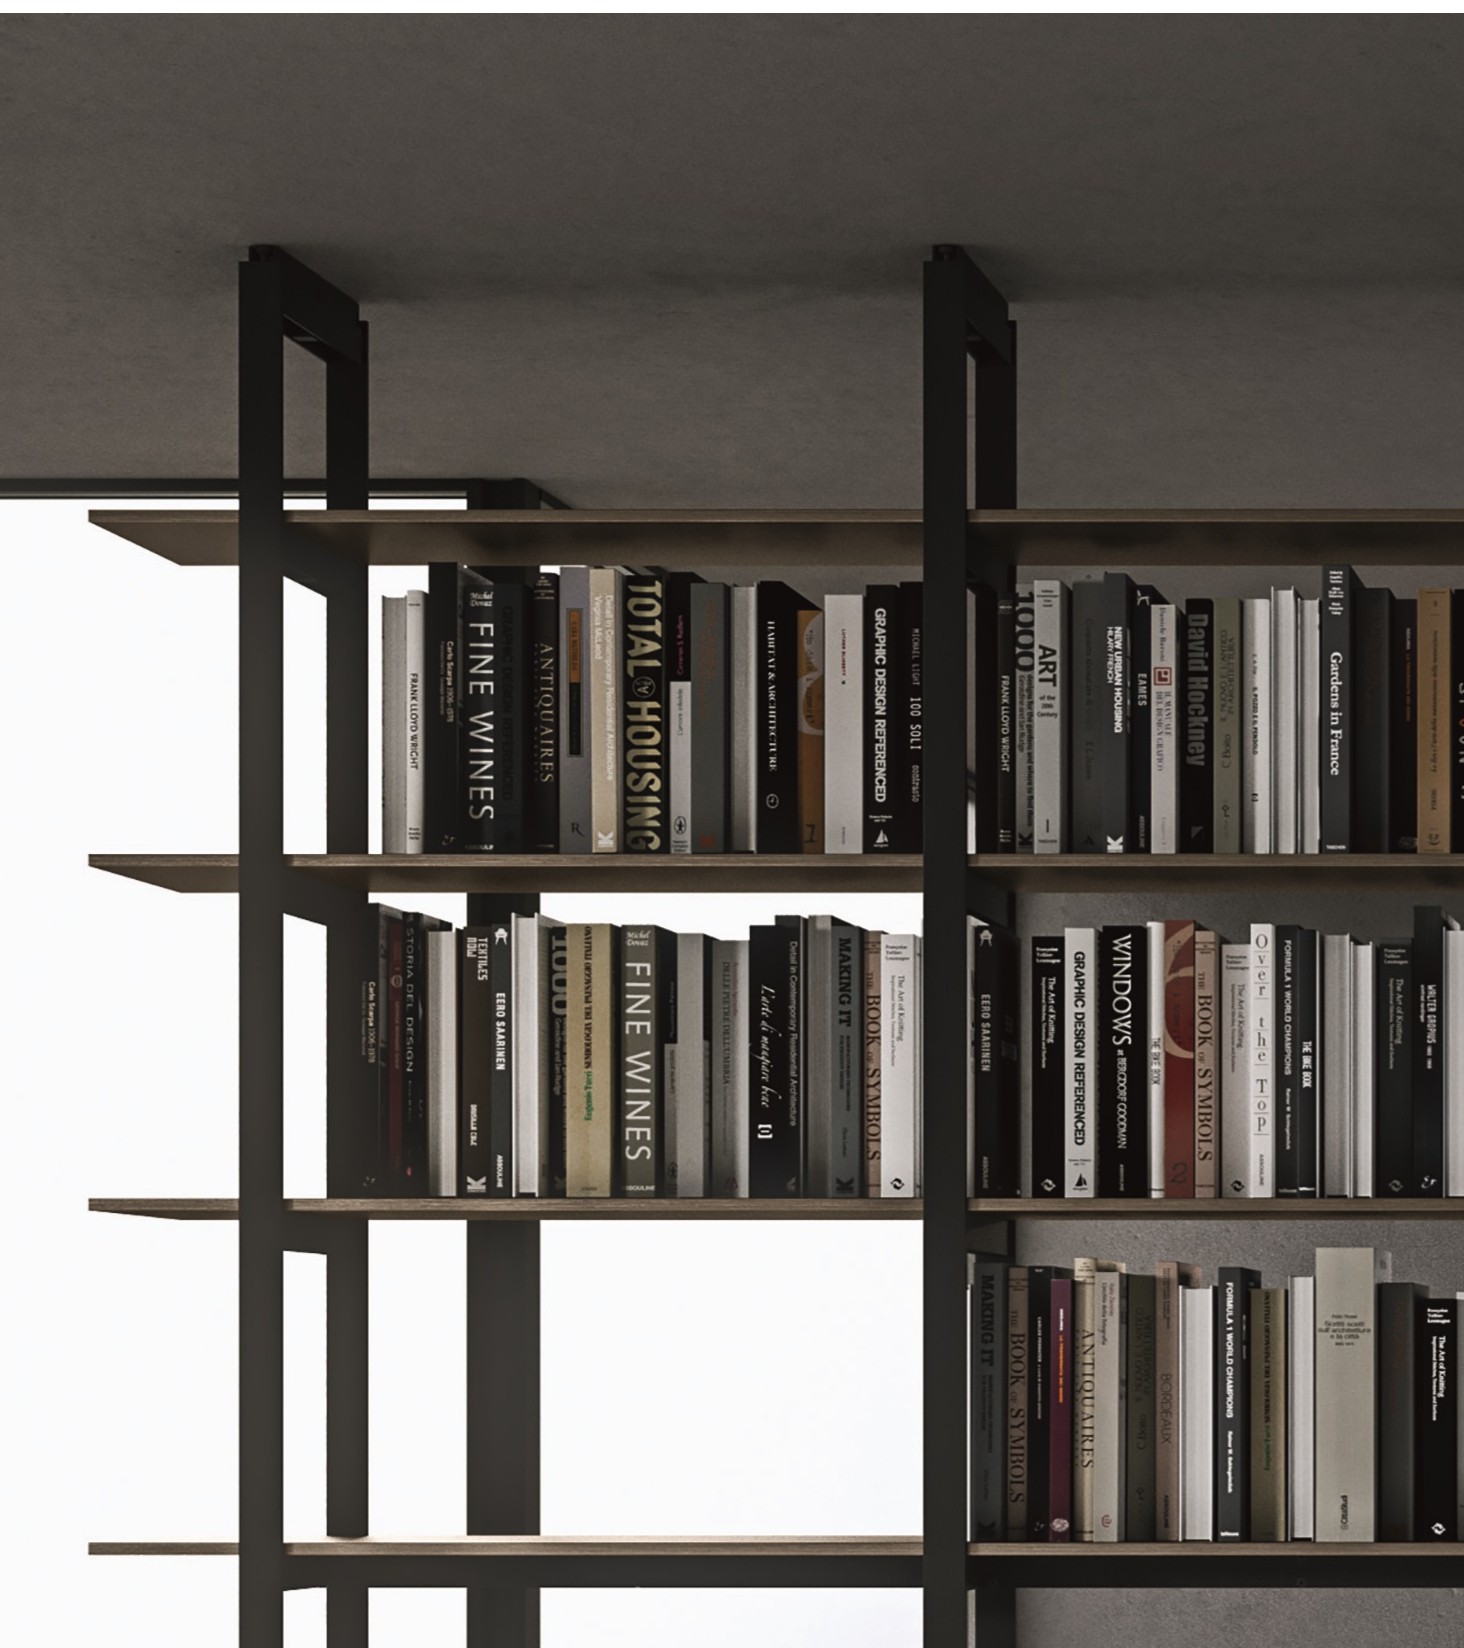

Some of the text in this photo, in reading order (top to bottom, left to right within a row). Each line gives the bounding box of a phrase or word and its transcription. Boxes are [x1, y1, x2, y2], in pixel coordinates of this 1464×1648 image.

[469, 623, 494, 819] FINE WINES
[537, 643, 554, 782] ANTIQUAIRES
[626, 580, 662, 851] TOTAL HOUSING
[874, 608, 886, 802] GRAPHIC DESIGN REFERENCED
[910, 628, 921, 802] MICHAEL LIGHT 100 SOLI contrasto
[1039, 645, 1056, 687] ART
[1114, 627, 1122, 733] NEW URBAN HOUSING
[1186, 613, 1208, 766] David Hockney
[1330, 651, 1342, 775] Gardens in France
[406, 928, 414, 1072] STORIA DEL DESIGN
[467, 937, 476, 958] NOW
[477, 937, 488, 980] TEXTILES
[838, 937, 852, 1027] MAKING IT
[1197, 972, 1205, 989] THE
[625, 962, 651, 1161] FINE WINES
[749, 984, 782, 1108] L'arte di mangiare bene
[1074, 952, 1085, 1145] GRAPHIC DESIGN REFERENCED
[1197, 995, 1212, 1047] BOOK
[1197, 1068, 1212, 1161] SYMBOLS
